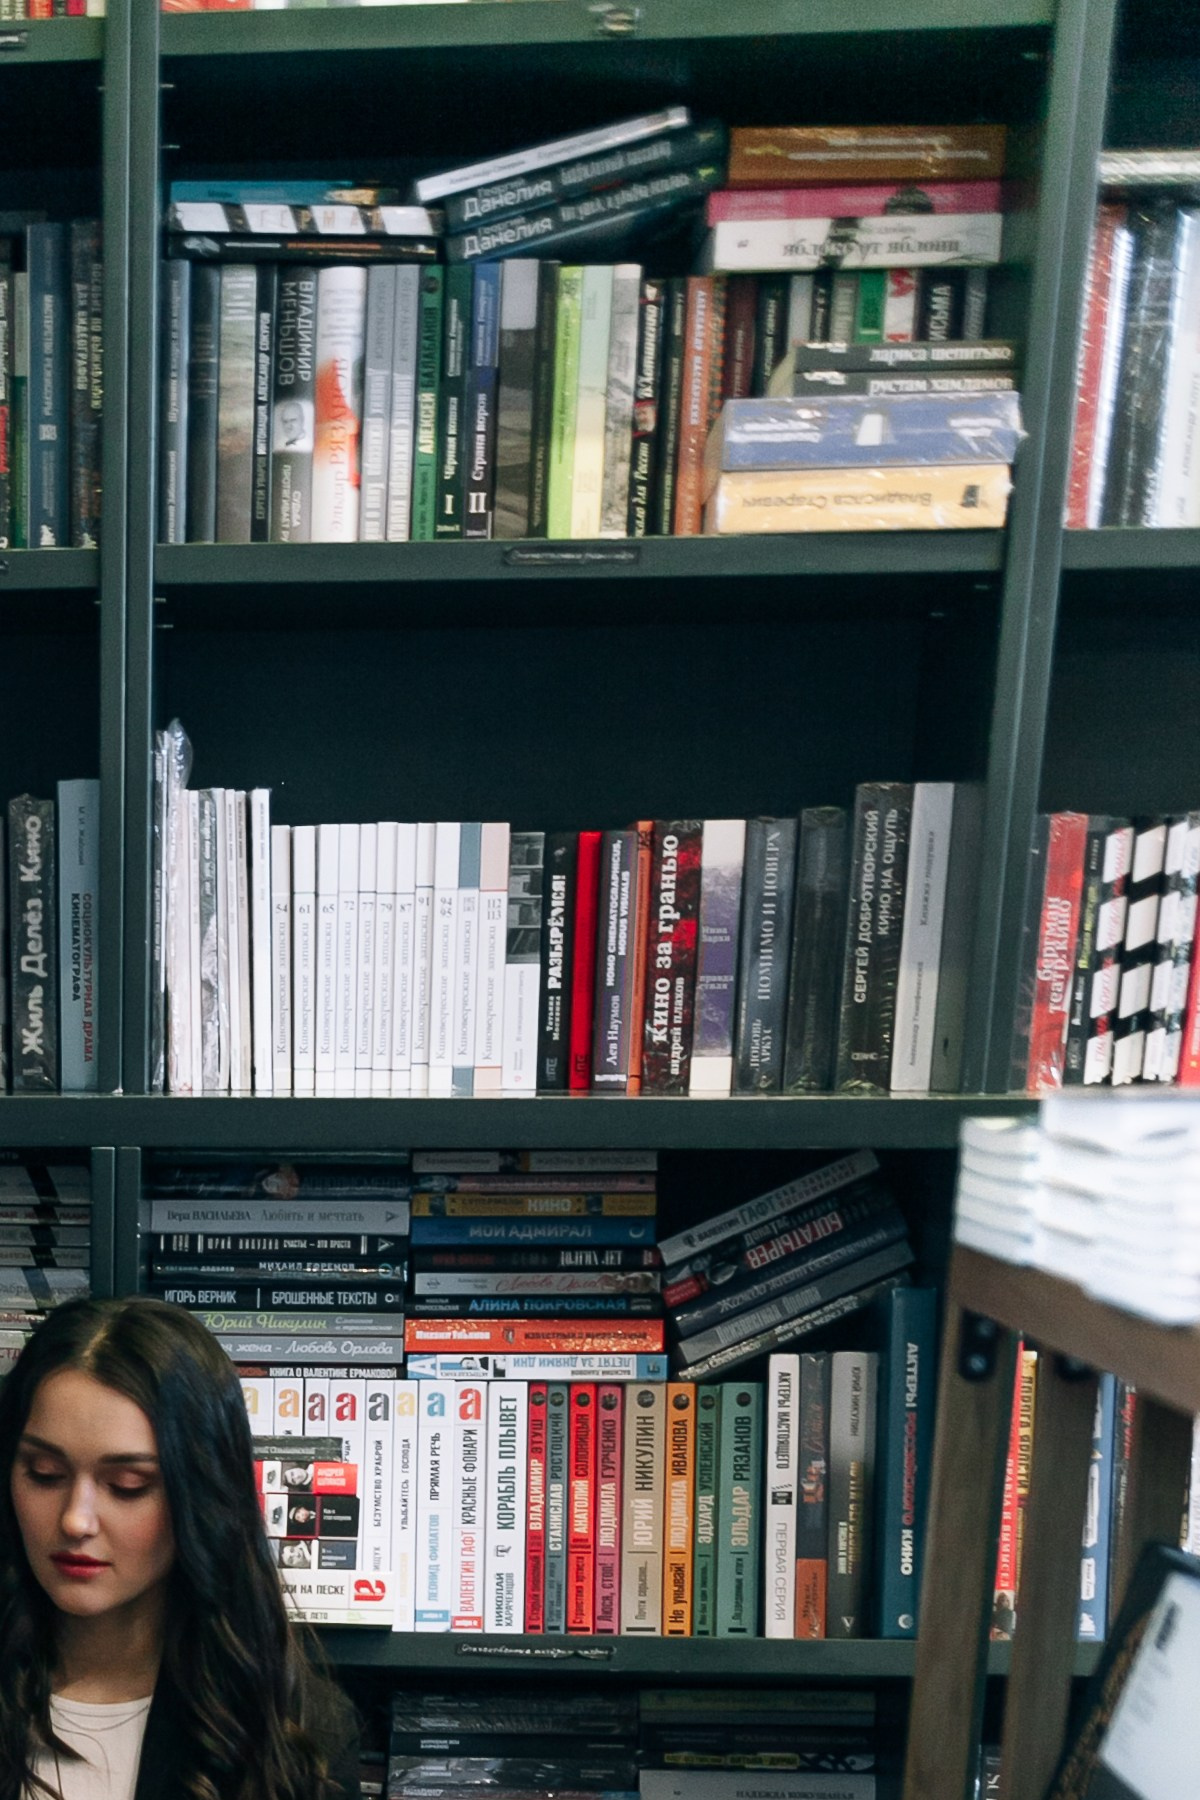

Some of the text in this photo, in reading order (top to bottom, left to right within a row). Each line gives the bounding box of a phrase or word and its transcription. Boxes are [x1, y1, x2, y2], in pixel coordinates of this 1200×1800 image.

[463, 180, 552, 220] Данелия
[463, 217, 551, 259] Данелия
[279, 282, 298, 386] МЕНЬШОВ
[299, 280, 314, 381] ВЛАДИМИР
[418, 307, 438, 454] АЛЕКСЕЙ БАЛАБАНОВ
[472, 393, 488, 481] Страна воров
[19, 815, 43, 881] Кино
[763, 831, 781, 896] ПОВЕРХ
[878, 808, 898, 934] КИНО НА ОЩУПЬ
[71, 893, 81, 1001] КИНЕМАТОГРАФА
[547, 874, 567, 989] РАЗБЕРЁМСЯ!
[606, 839, 622, 986] HOMO CINEMATOGRAPHICUS,
[618, 871, 630, 955] MODUS VISUALIS
[650, 835, 680, 1043] кино за гранью
[854, 810, 879, 1003] СЕРГЕЙ ДОБРОТВОРСКИЙ
[1037, 896, 1061, 980] бергман
[83, 893, 92, 1062] СОЦИОКУЛЬТУРНАЯ ДРАМА
[757, 920, 776, 1000] ПОМИМО
[1047, 900, 1072, 1012] театр. кино
[21, 984, 45, 1054] Жиль
[606, 995, 622, 1065] Лев Наумов
[670, 977, 684, 1075] андрей плахов
[470, 1227, 592, 1239] МОЙ АДМИРАЛ
[164, 1290, 237, 1304] ИГОРЬ ВЕРНИК
[272, 1291, 377, 1305] БРОШЕННЫЕ ТЕКСТЫ
[469, 1299, 627, 1312] АЛИНА ПОКРОВСКАЯ
[430, 1433, 440, 1501] ПРЯМАЯ РЕЧЬ
[461, 1429, 478, 1524] КРАСНЫЕ ФОНАРИ
[497, 1396, 517, 1530] КОРАБЛЬ ПЛЫВЕТ
[549, 1413, 564, 1551] СТАНИСЛАВ РОСТОЦКИЙ
[573, 1414, 589, 1533] АНАТОЛИЙ СОЛОНИЦЫН
[599, 1419, 617, 1547] ЛЮДМИЛА ГУРЧЕНКО
[630, 1416, 654, 1546] ЮРИЙ НИКУЛИН
[670, 1419, 687, 1548] ЛЮДМИЛА ИВАНОВА
[698, 1422, 714, 1544] ЭДУАРД УСПЕНСКИЙ
[731, 1416, 751, 1546] ЭЛЬДАР РЯЗАНОВ
[901, 1343, 918, 1576] АКТЕРЫ РОССИЙСКОГО КИНО
[427, 1514, 439, 1602] ЛЕОНИД ФИЛАТОВ
[459, 1530, 476, 1612] ВАЛЕНТИН ГАФТ
[495, 1572, 504, 1627] НИКОЛАЙ
[505, 1572, 514, 1627] КАРАЧЕНЦОВ
